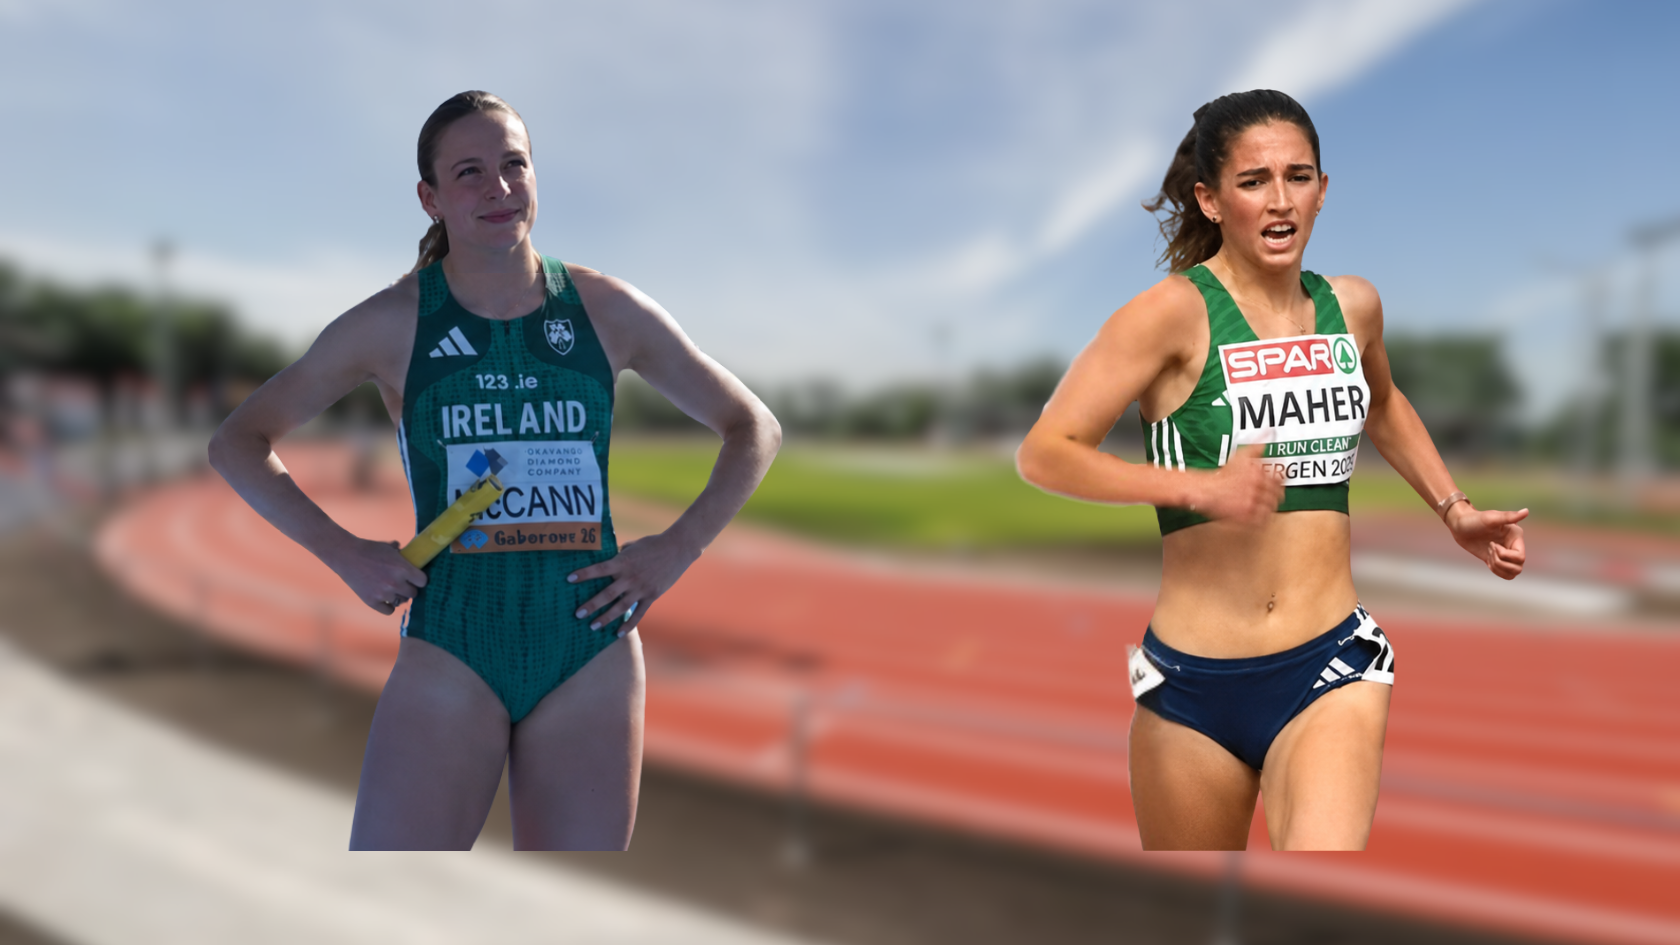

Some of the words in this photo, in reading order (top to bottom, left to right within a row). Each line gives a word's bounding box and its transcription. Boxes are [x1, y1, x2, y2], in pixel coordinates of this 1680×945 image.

[1228, 343, 1333, 378] SPAR
[475, 374, 509, 390] 123
[515, 374, 538, 389] .ie
[1237, 385, 1365, 430] MAHER
[441, 400, 587, 439] IRELAND
[1269, 444, 1273, 456] I
[1277, 441, 1307, 456] RUN
[1310, 438, 1349, 453] CLEAN
[527, 468, 581, 476] COMPANY
[1261, 460, 1326, 480] ERGEN
[581, 528, 596, 543] 26
